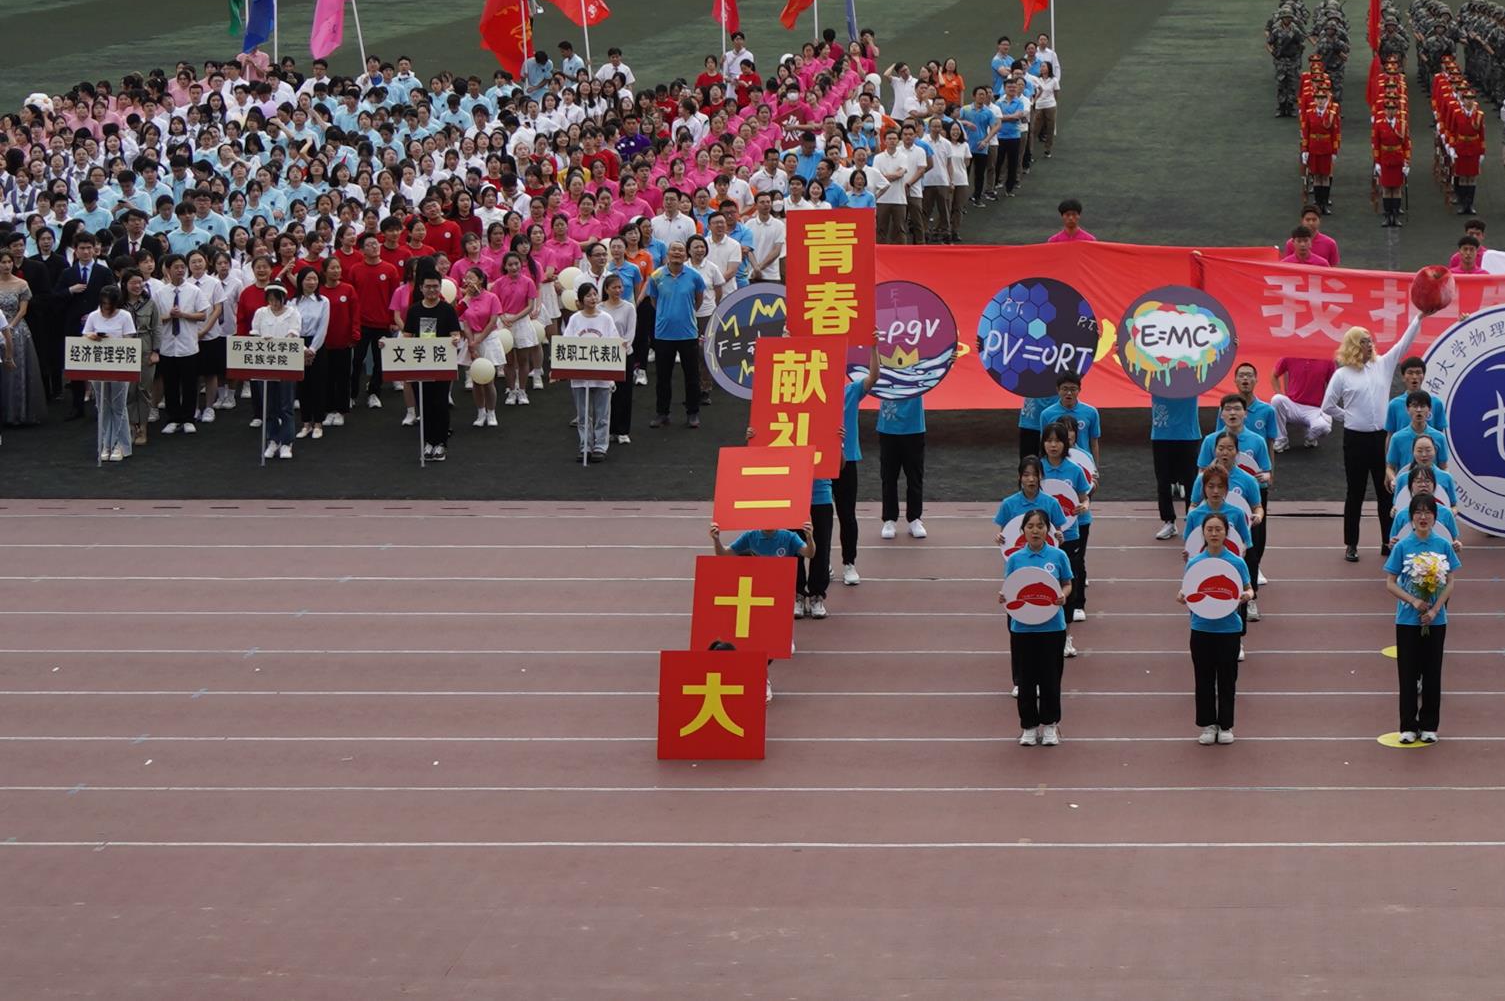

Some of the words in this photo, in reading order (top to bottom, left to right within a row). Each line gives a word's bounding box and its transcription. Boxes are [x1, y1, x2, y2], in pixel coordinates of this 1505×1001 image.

[803, 221, 859, 335] 青春
[70, 345, 137, 364] 经济管理学院
[232, 340, 300, 353] 历史文化学院
[243, 354, 288, 366] 民族学院
[393, 345, 447, 363] 文学院
[555, 344, 622, 363] 教职工代表队
[769, 350, 829, 464] 献礼
[733, 466, 791, 509] 二
[713, 576, 775, 638] 十
[679, 672, 745, 738] 大
